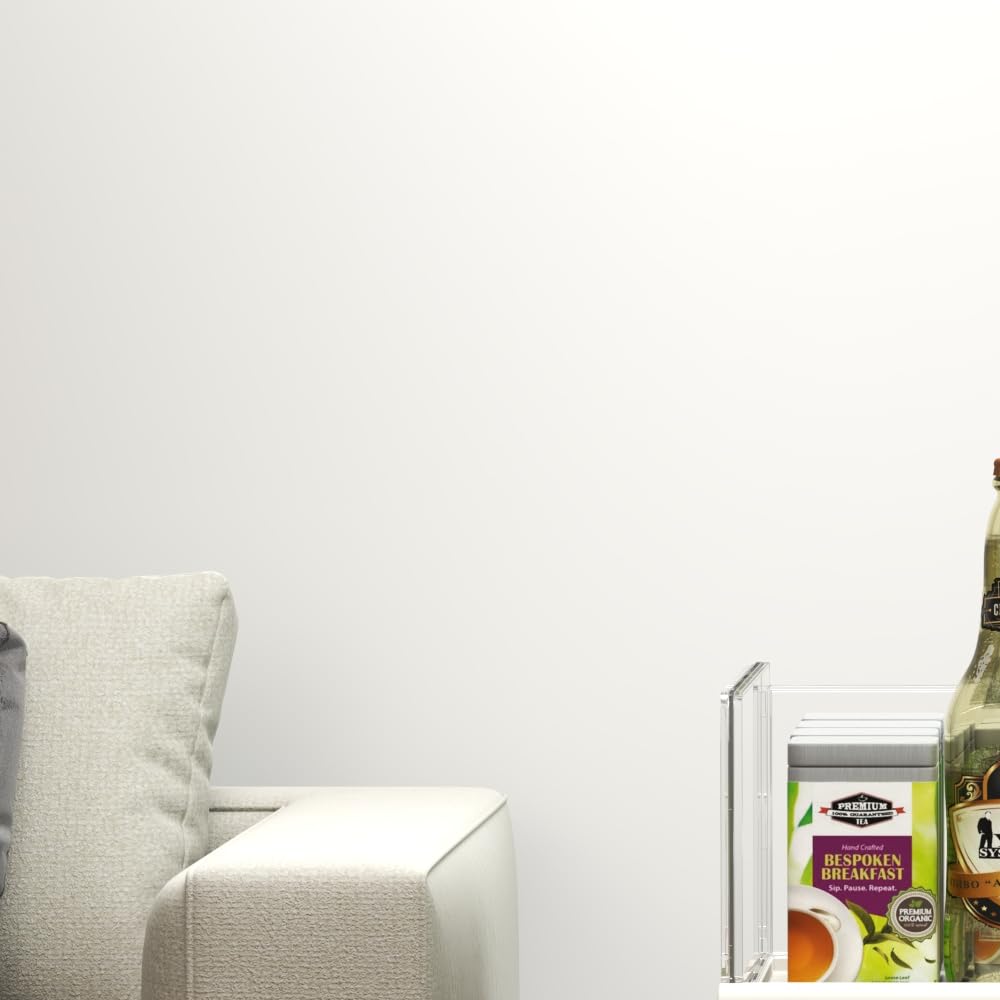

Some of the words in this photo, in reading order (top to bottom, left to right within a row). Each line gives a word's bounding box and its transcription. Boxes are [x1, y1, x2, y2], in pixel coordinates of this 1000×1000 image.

[838, 802, 887, 810] PREMIUM
[824, 854, 901, 866] BESPOKEN
[821, 867, 904, 880] BREAKFAST
[828, 884, 842, 892] Sip.
[869, 884, 897, 892] Repeat.
